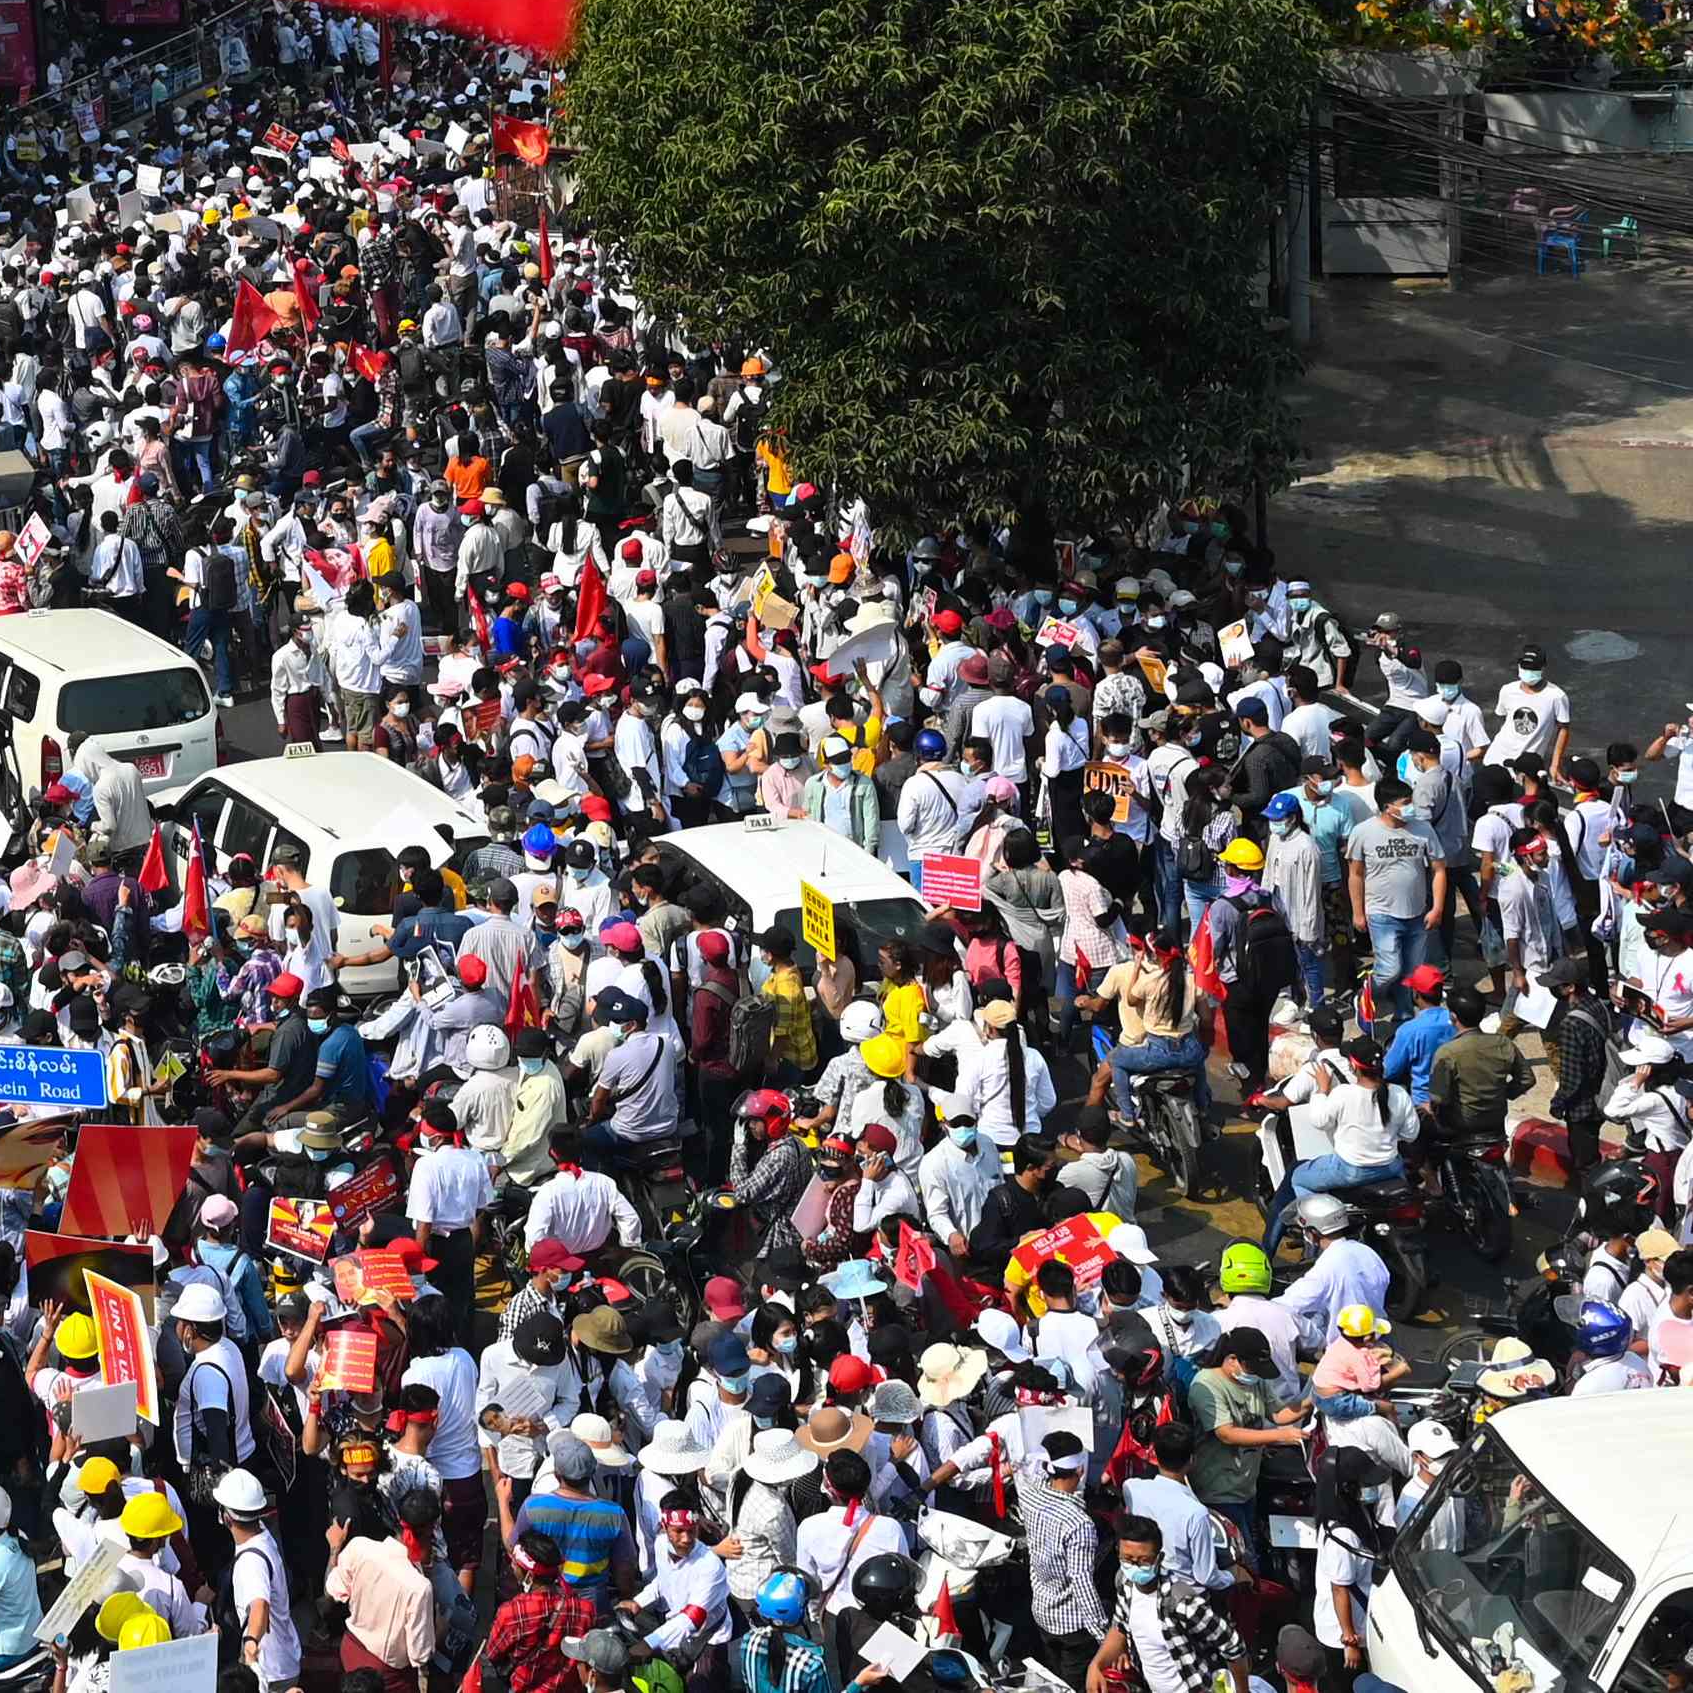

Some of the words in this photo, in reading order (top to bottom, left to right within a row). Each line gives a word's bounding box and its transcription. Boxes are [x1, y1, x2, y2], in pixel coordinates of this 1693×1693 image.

[749, 817, 773, 828] TAXI
[40, 1081, 82, 1101] Road
[1031, 1232, 1056, 1251] HELP
[1055, 1225, 1071, 1239] US
